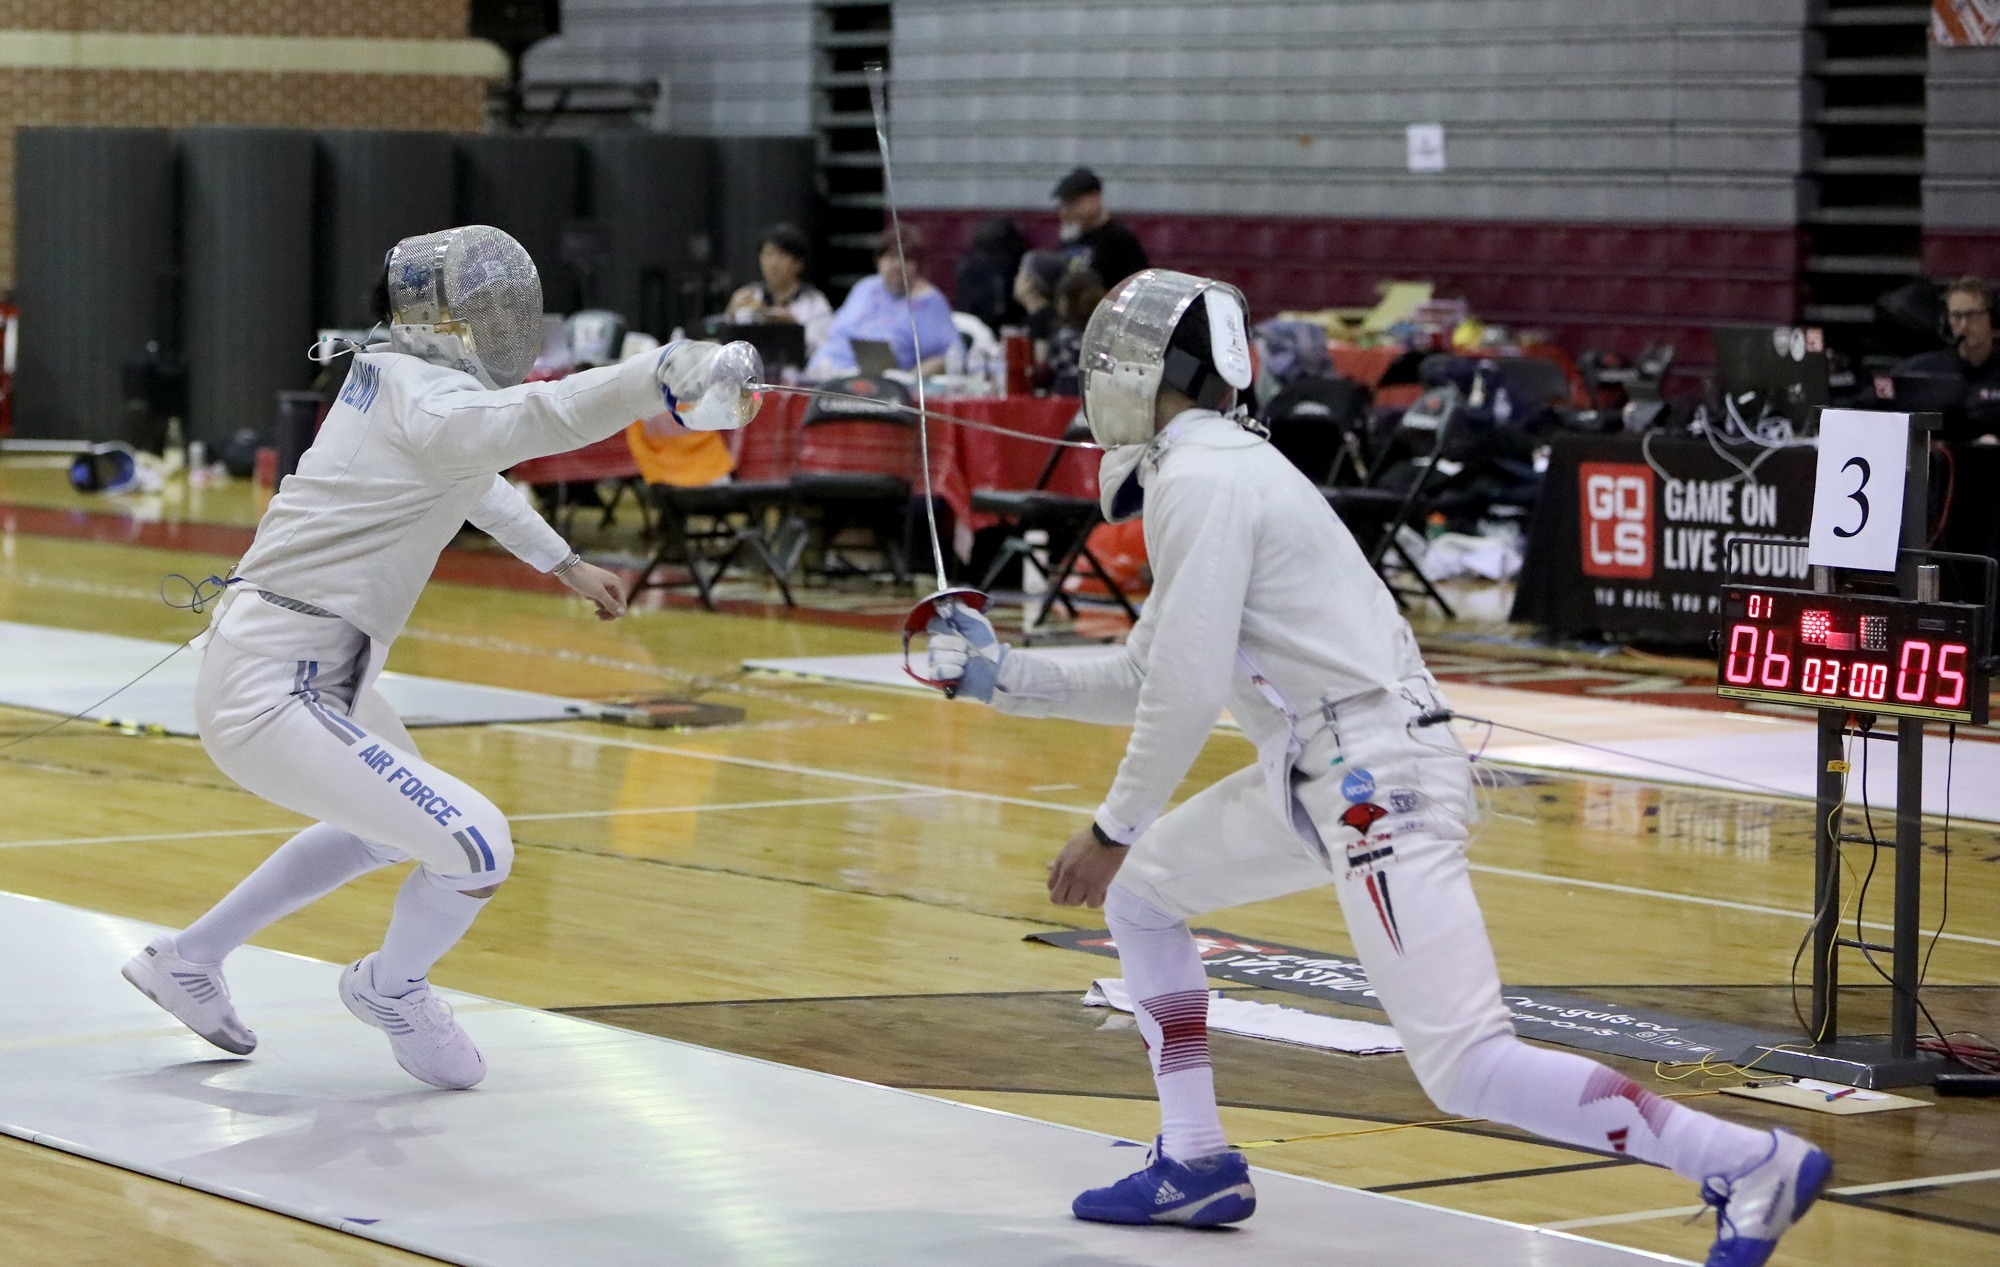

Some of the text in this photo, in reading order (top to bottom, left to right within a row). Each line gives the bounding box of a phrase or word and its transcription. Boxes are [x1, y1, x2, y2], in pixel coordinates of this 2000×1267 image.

[1663, 478, 1777, 528] GAME ON
[1833, 456, 1871, 538] 3
[1663, 527, 1717, 572] LIVE
[1749, 595, 1772, 618] 01
[1726, 625, 1790, 688] 06
[1802, 658, 1887, 700] 03:00
[1896, 641, 1967, 706] 05
[357, 743, 463, 827] AIR FORCE
[1155, 1191, 1186, 1205] adidas
